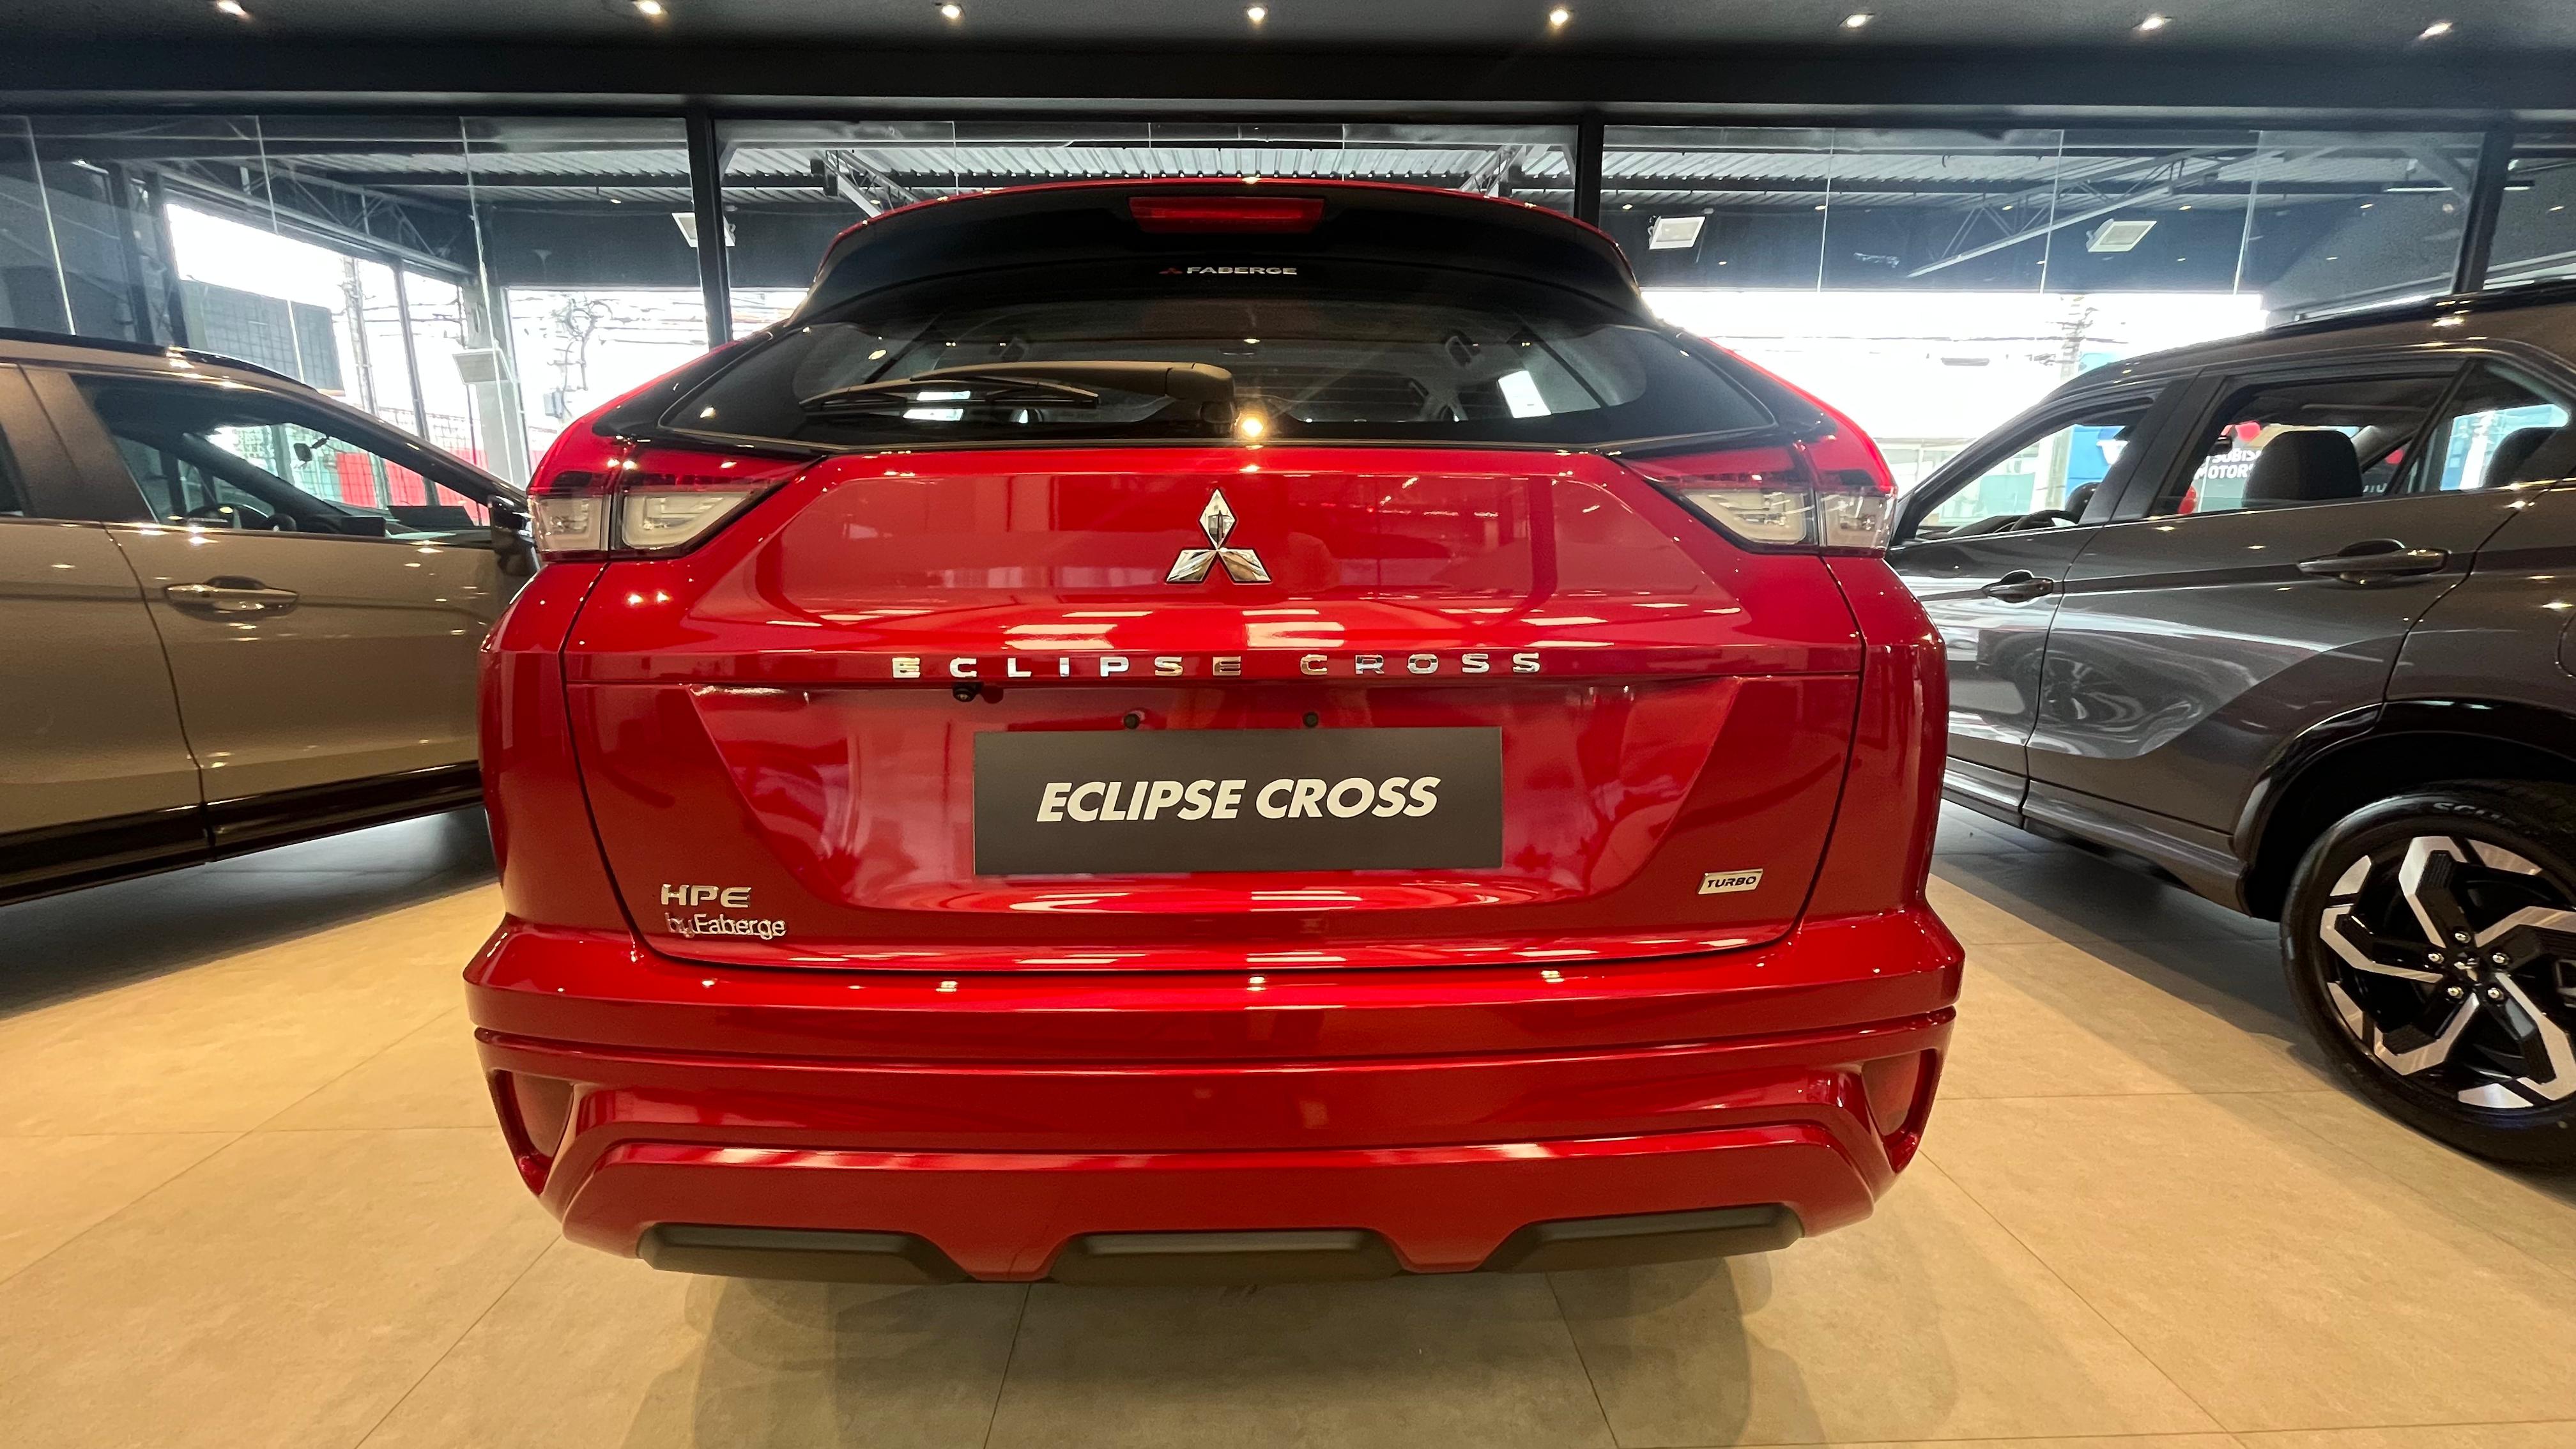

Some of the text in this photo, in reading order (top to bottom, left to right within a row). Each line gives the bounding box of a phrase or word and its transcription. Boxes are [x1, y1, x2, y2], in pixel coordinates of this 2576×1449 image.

[1186, 266, 1297, 275] FABERGE
[2194, 463, 2253, 479] MOTOR
[892, 653, 1540, 678] ECLIPSE CROSS
[1036, 776, 1441, 822] ECLIPSE CROSS
[1708, 876, 1756, 887] TURBO
[661, 884, 751, 908] HPE
[664, 912, 787, 940] by Faberge
